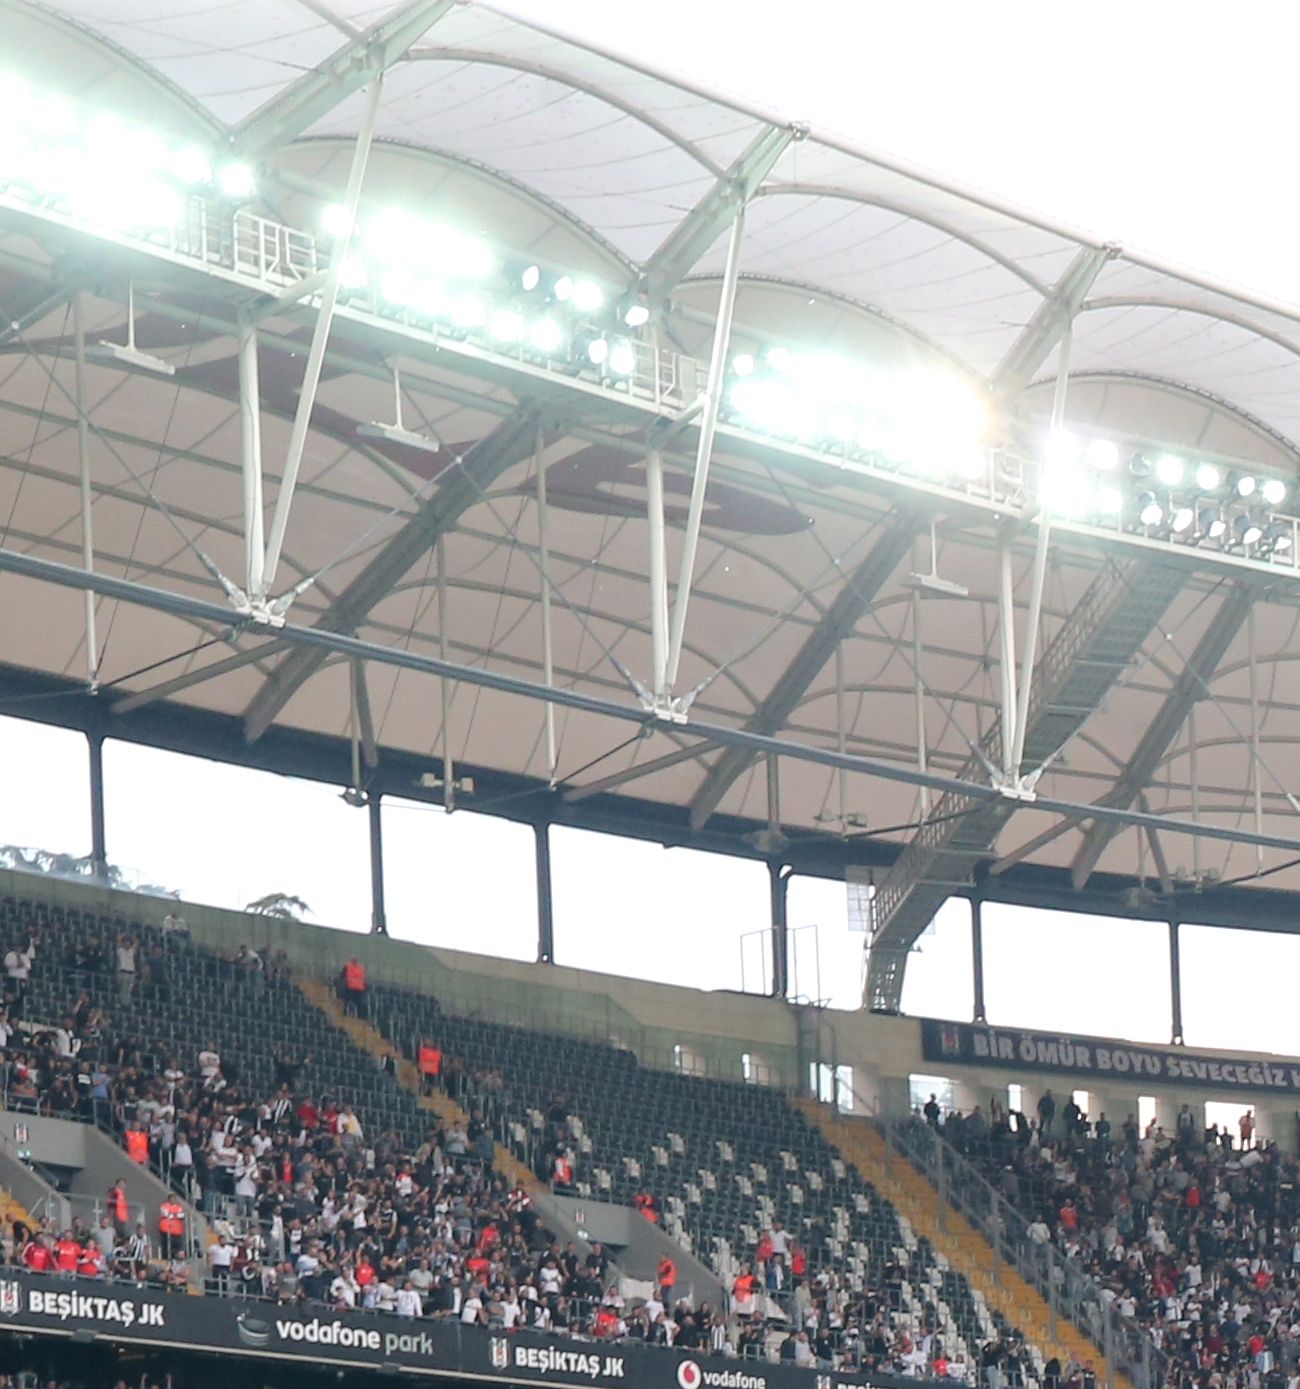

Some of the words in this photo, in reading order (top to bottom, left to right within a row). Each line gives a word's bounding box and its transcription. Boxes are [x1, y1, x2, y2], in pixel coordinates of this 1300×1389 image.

[973, 1030, 1015, 1060] BİR
[1020, 1034, 1092, 1068] ÖMÜR
[1096, 1048, 1161, 1074] BOYU
[1166, 1055, 1287, 1087] SEVECEĞİZ
[28, 1290, 135, 1328] BEŞİKTAŞ
[138, 1303, 165, 1327] JK
[276, 1318, 381, 1350] vodafone
[384, 1333, 434, 1356] park
[515, 1346, 600, 1376] BEŞİKTAŞ
[602, 1356, 624, 1378] JK
